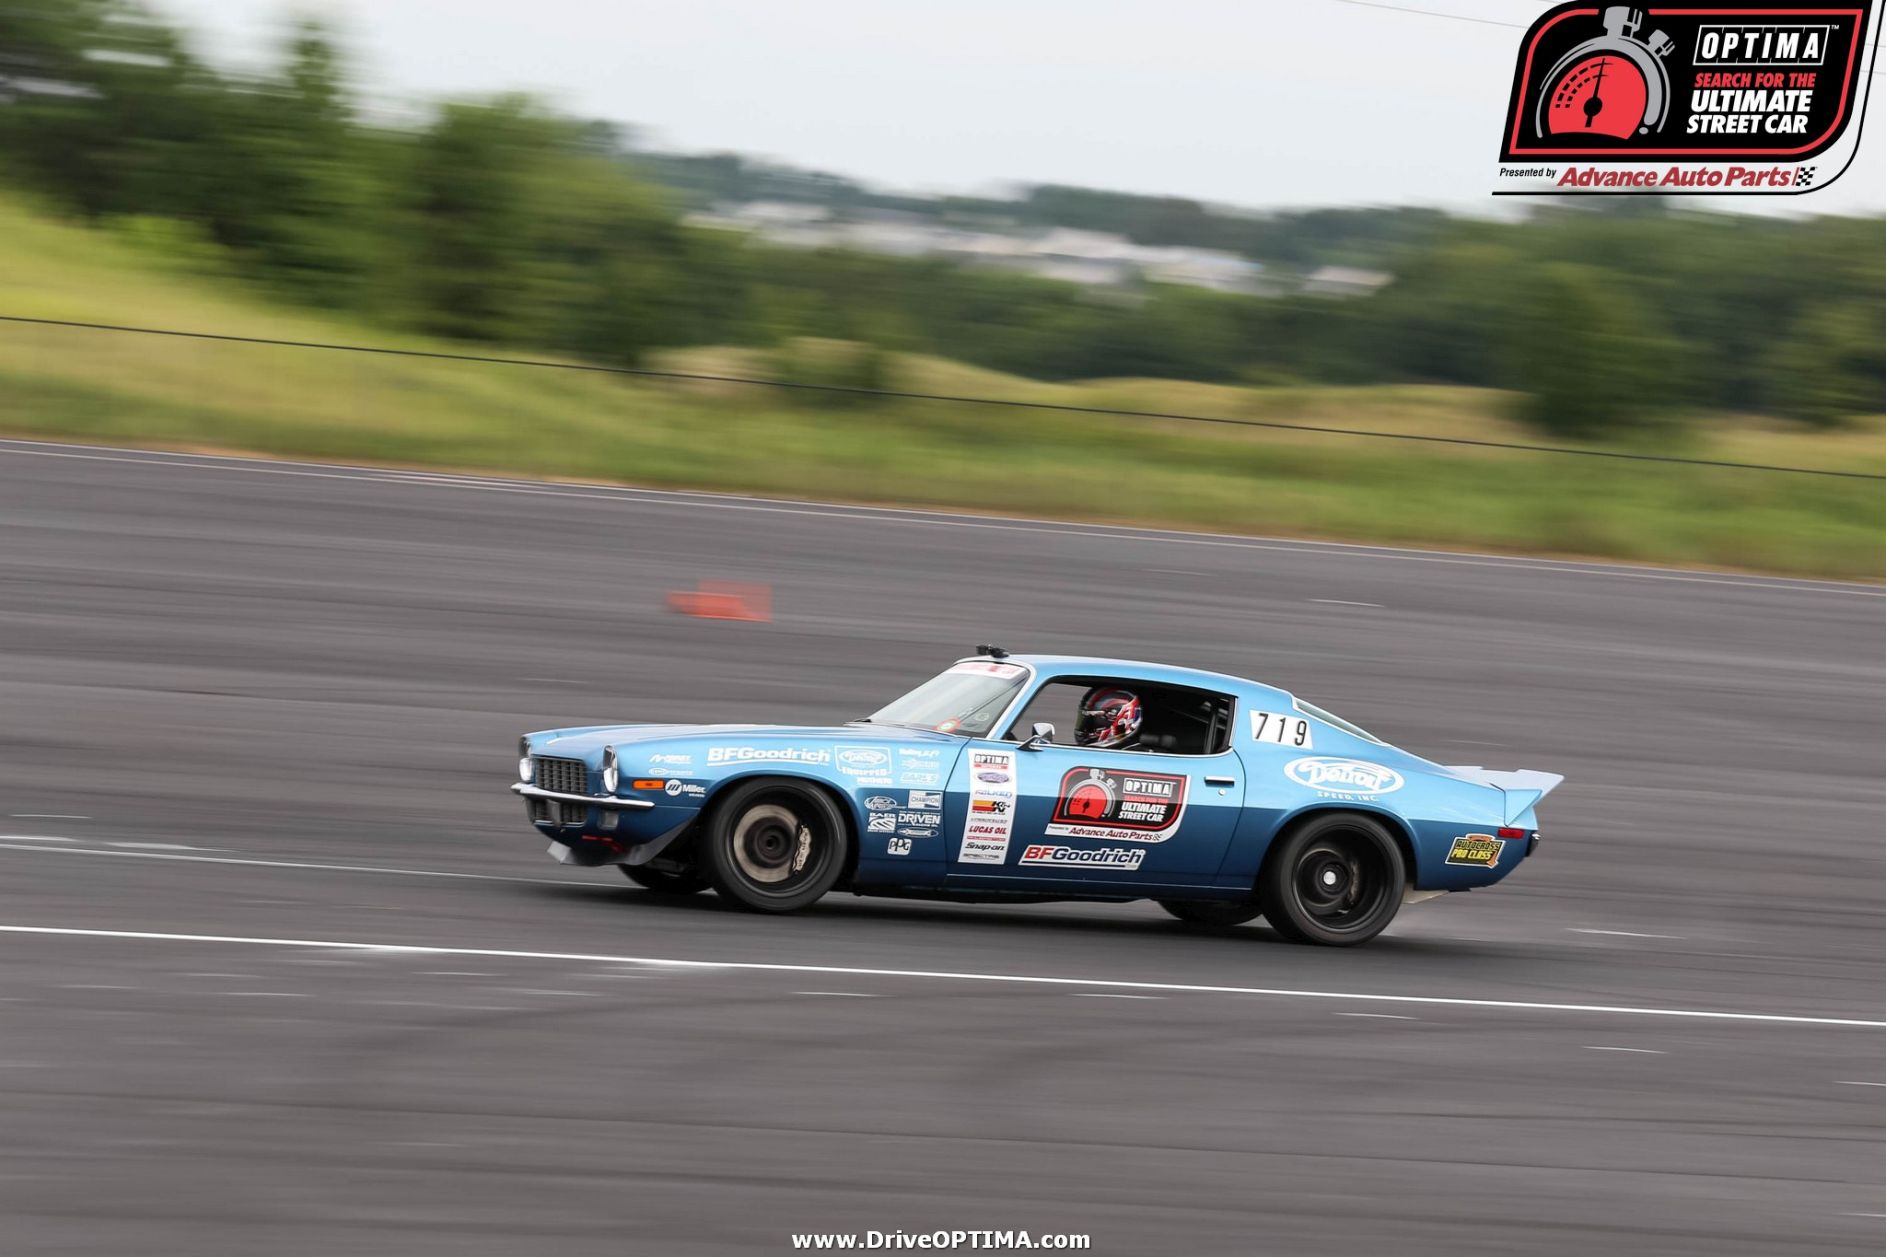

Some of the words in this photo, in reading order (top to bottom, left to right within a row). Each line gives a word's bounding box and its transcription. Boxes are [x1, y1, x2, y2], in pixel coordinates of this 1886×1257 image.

[1255, 712, 1307, 746] 719
[707, 747, 831, 762] BFGoodrich
[1125, 780, 1170, 795] OPTIMA
[1121, 801, 1167, 814] ULTIMATE
[898, 813, 941, 825] DRIVEN
[1118, 811, 1147, 821] STREET
[1146, 813, 1164, 822] CAR
[968, 826, 994, 834] LUCAS
[1069, 827, 1105, 837] Advance
[1105, 830, 1128, 839] Auto
[1128, 831, 1153, 841] Parts
[1024, 847, 1142, 863] BFGoodrich
[1451, 849, 1468, 858] PRO
[1468, 850, 1492, 860] CLASS
